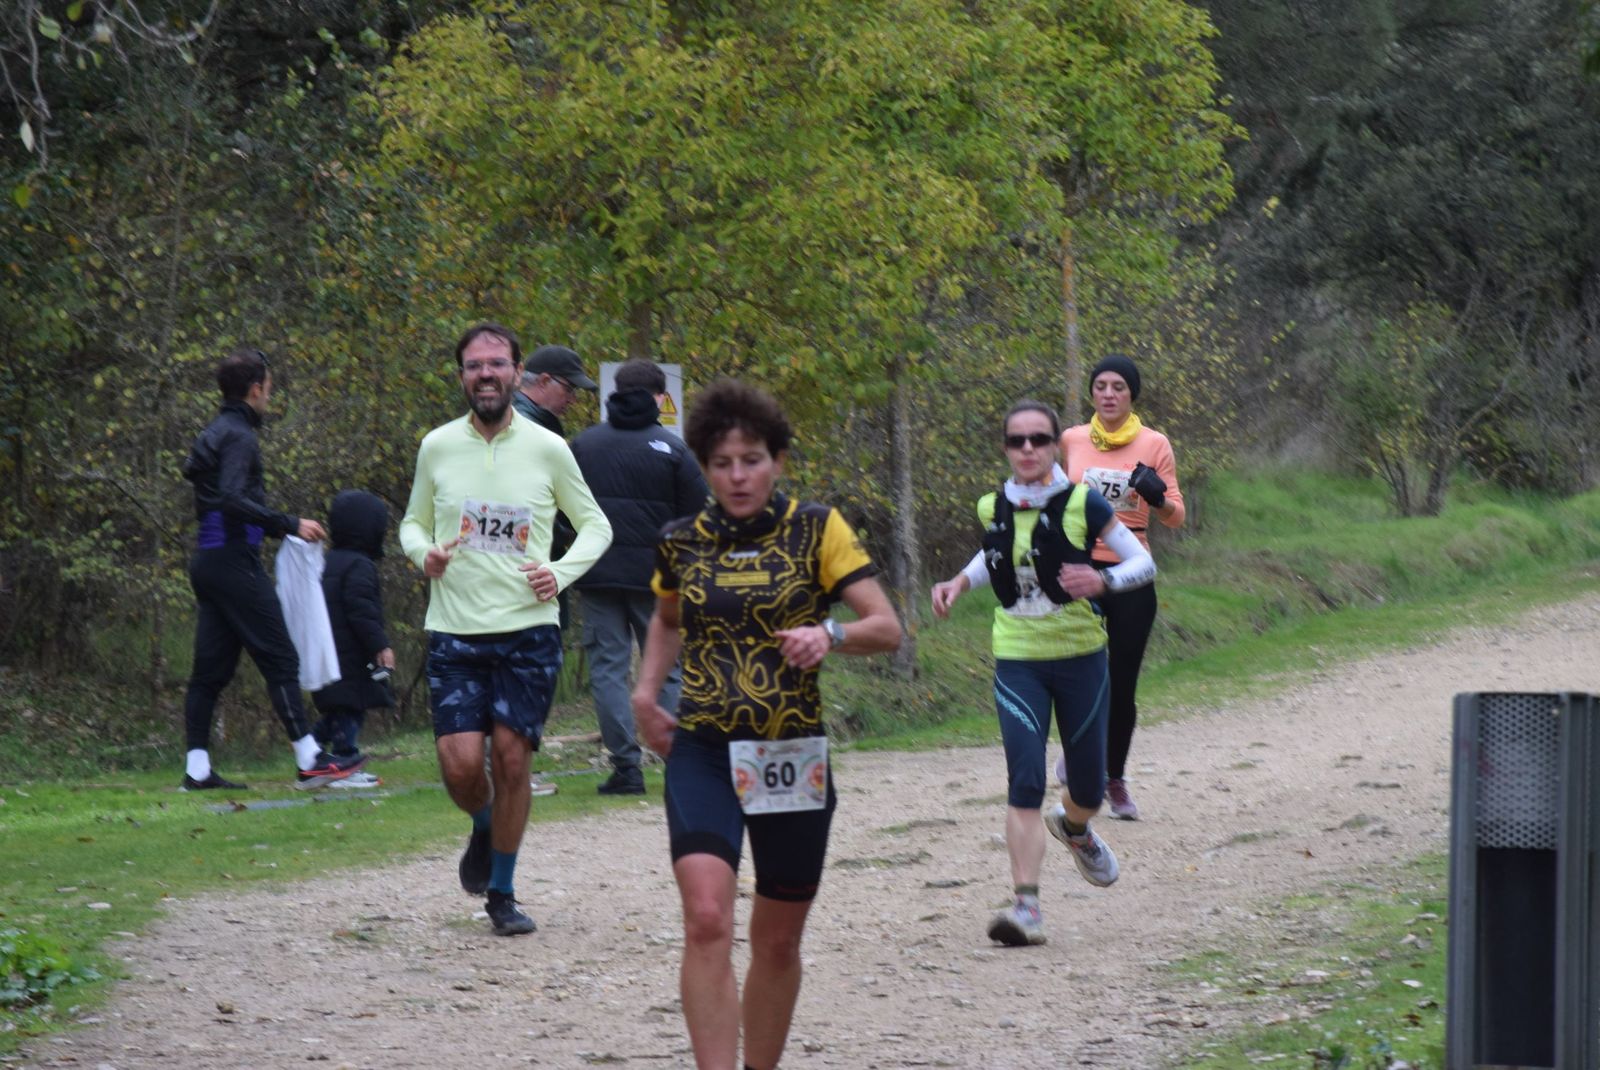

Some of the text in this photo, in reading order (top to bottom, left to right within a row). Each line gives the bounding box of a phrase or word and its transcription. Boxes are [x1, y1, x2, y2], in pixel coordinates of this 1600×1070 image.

[1101, 482, 1121, 498] 75
[478, 517, 514, 539] 124
[764, 761, 796, 788] 60
